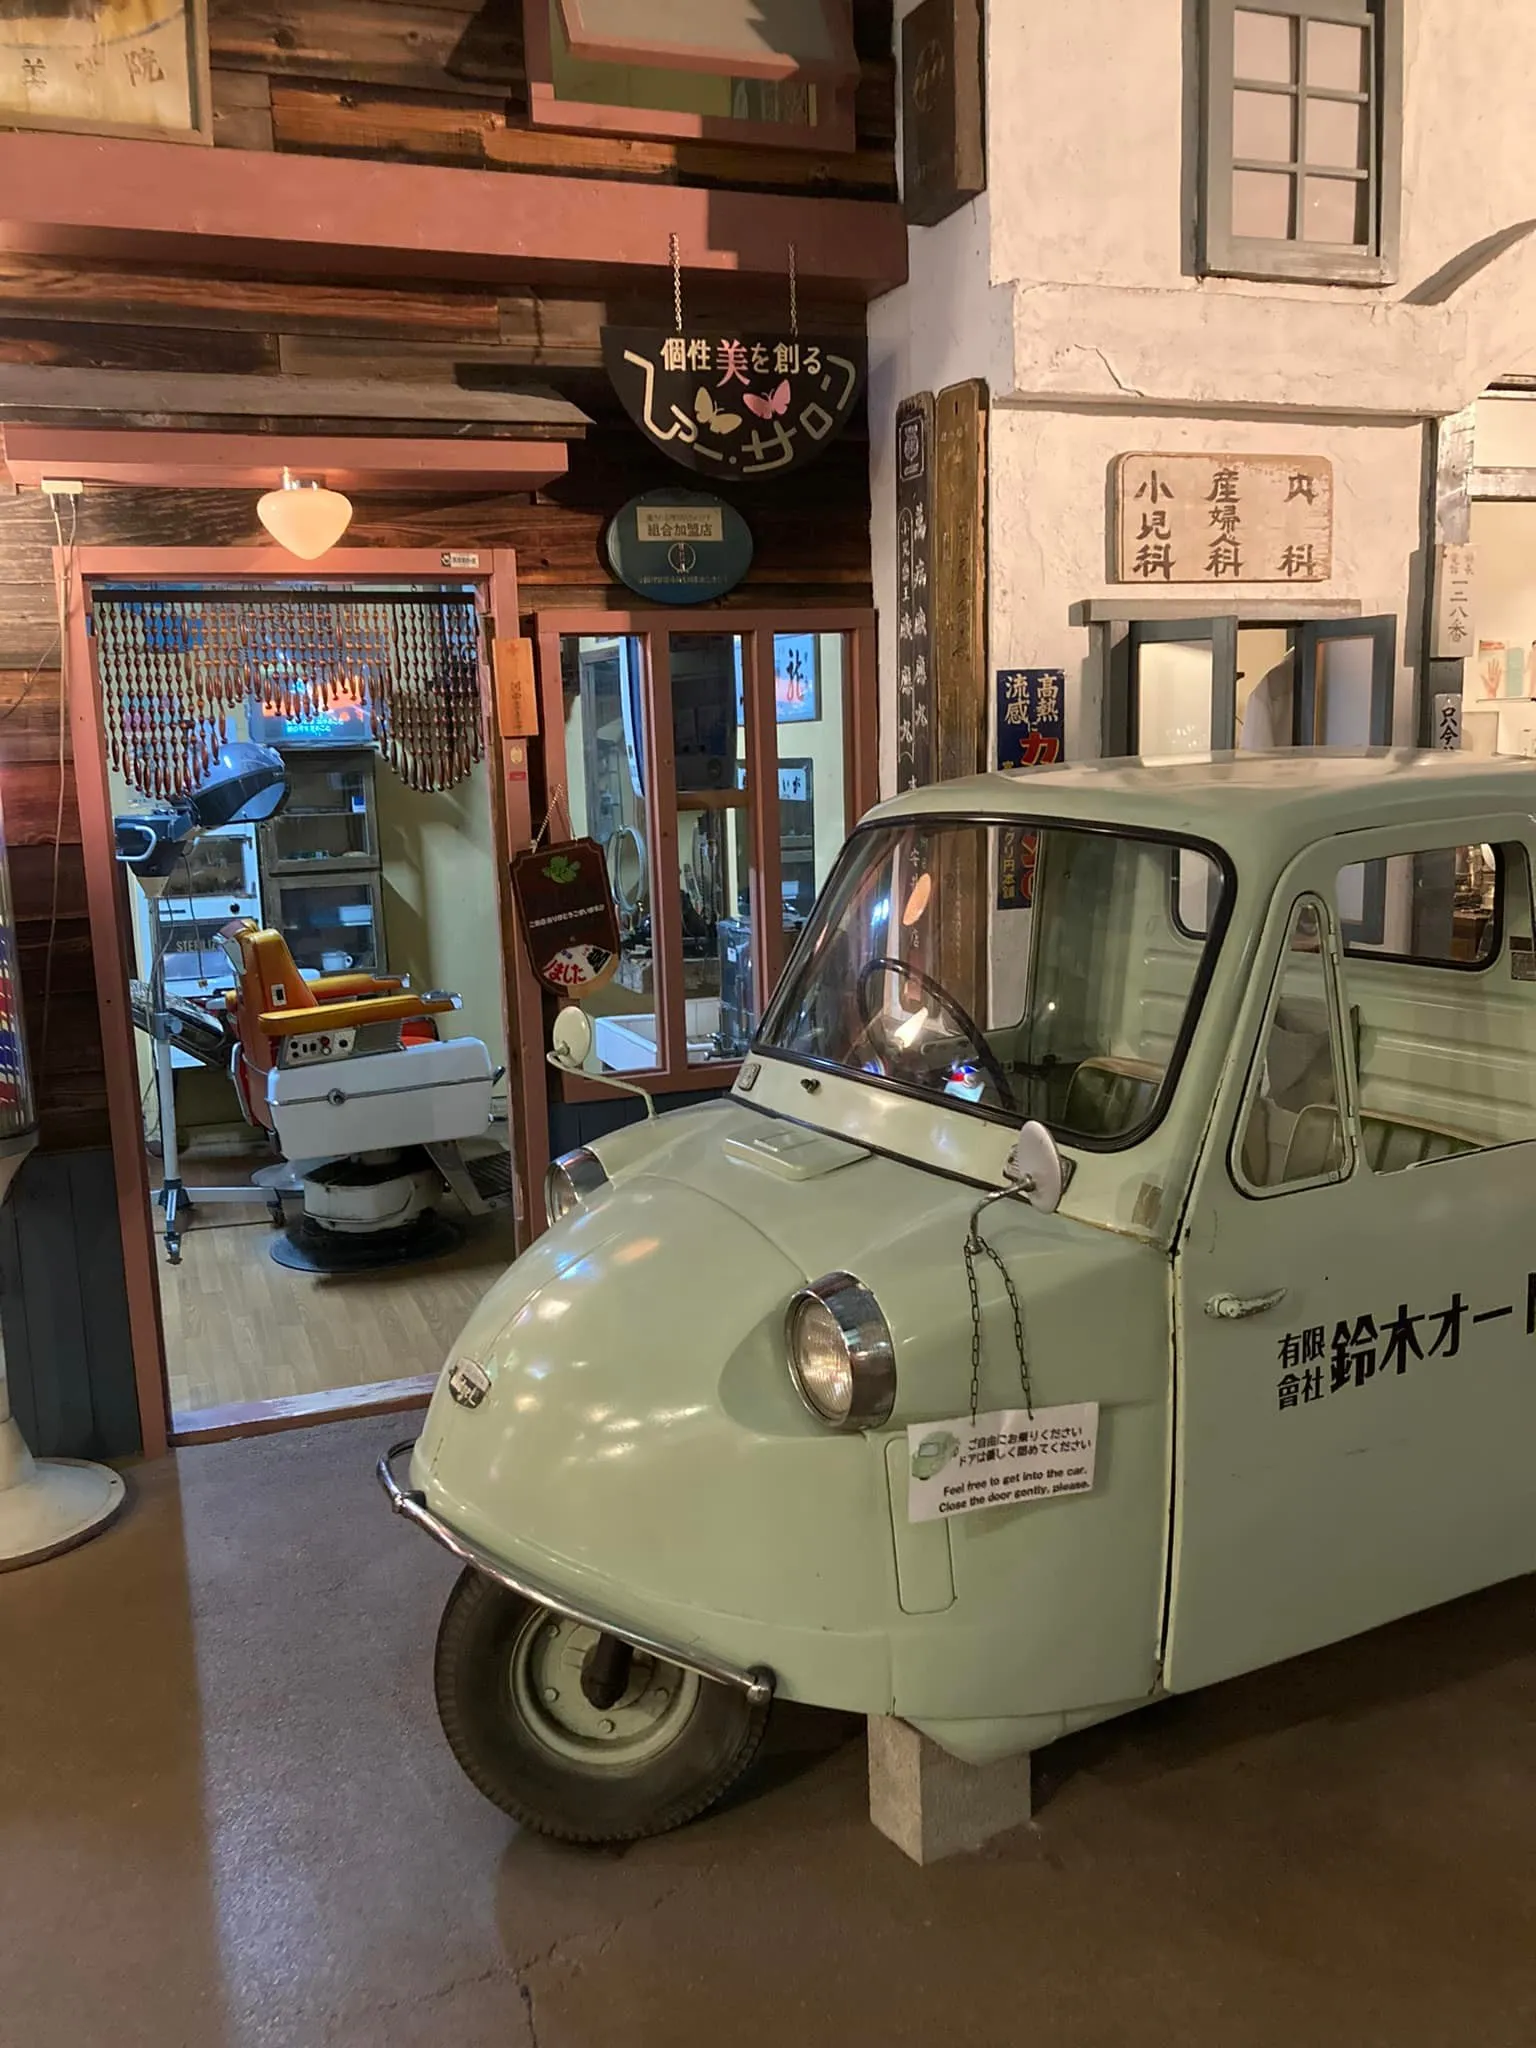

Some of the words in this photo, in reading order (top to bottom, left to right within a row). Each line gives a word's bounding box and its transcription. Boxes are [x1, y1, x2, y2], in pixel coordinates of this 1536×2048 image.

[660, 337, 822, 388] 個性美を創る
[647, 522, 713, 537] 組合加盟店
[1132, 470, 1176, 580] 小児科
[1204, 467, 1245, 578] 産婦人科
[1277, 473, 1319, 578] 内科
[1004, 673, 1030, 726] 流感
[1036, 673, 1060, 722] 高熱
[1439, 706, 1459, 750] 只今
[1276, 1325, 1325, 1369] 有限
[1276, 1366, 1324, 1411] 會社
[968, 1426, 1083, 1451] ご自由にお乗りください
[938, 1500, 967, 1513] Close
[970, 1495, 985, 1507] the
[988, 1491, 1013, 1502] door
[1014, 1485, 1050, 1499] gently,
[1052, 1480, 1091, 1493] please.
[943, 1482, 965, 1497] Feel
[967, 1480, 987, 1491] free
[990, 1476, 1000, 1487] to
[1003, 1473, 1020, 1486] get
[1022, 1471, 1043, 1481] into
[1046, 1468, 1064, 1479] the
[1067, 1466, 1088, 1477] car.
